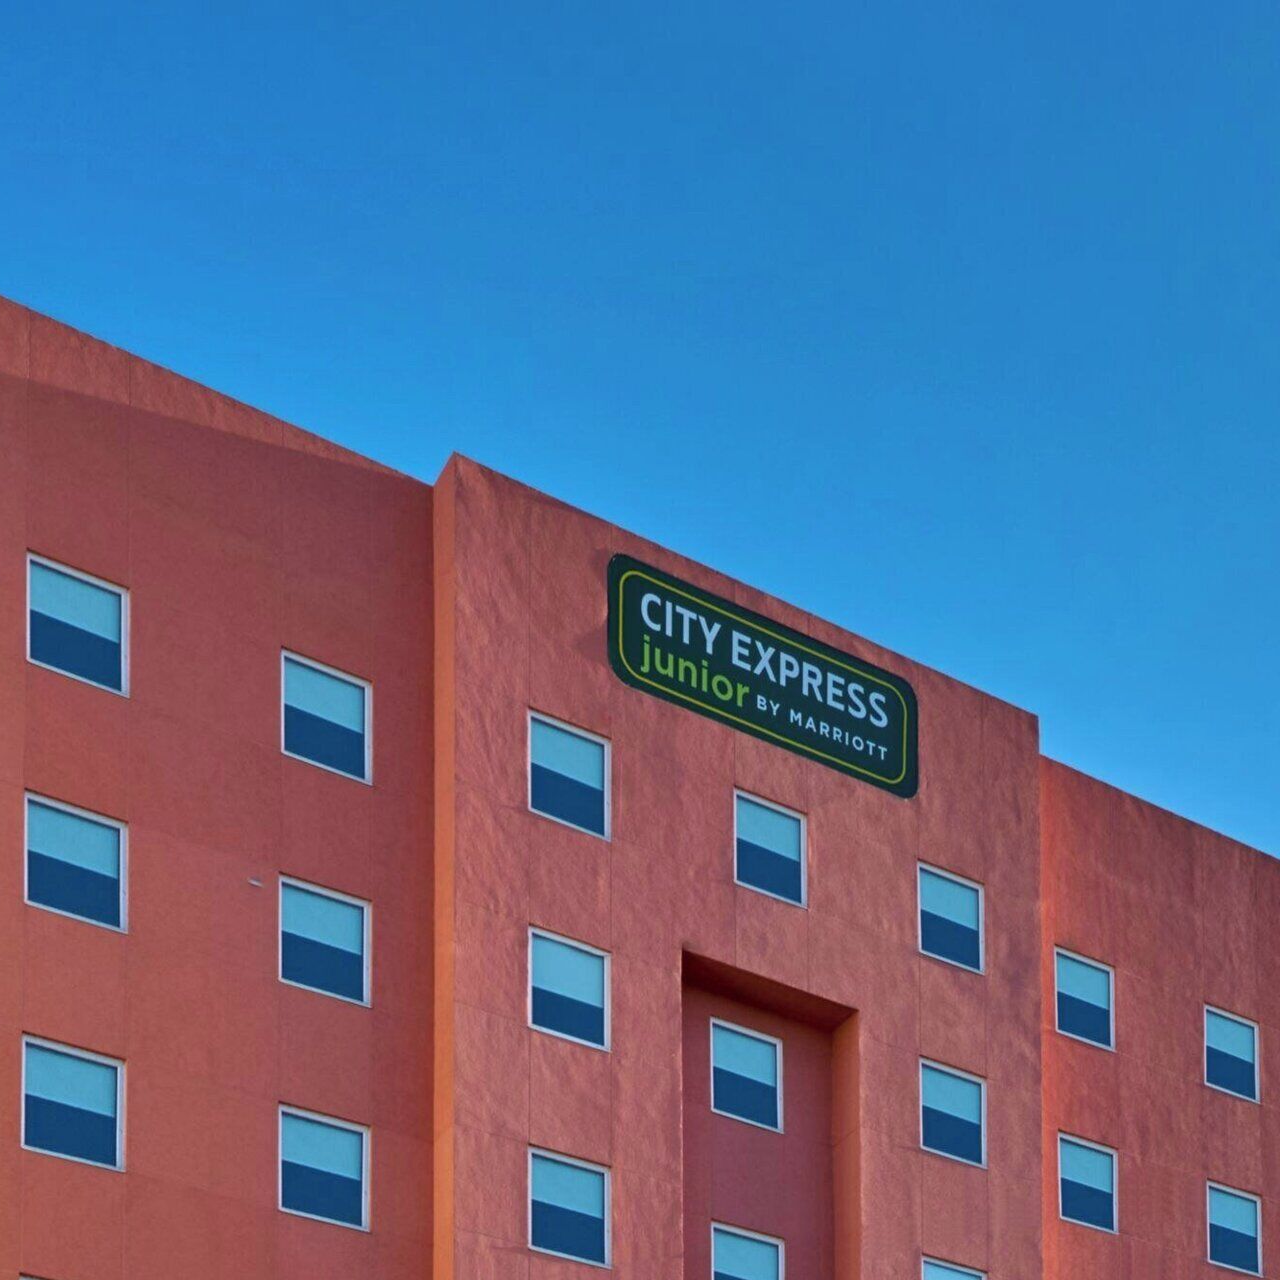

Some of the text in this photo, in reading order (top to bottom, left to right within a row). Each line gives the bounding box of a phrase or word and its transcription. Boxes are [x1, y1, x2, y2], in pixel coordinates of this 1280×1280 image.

[640, 593, 889, 728] CITY EXPRESS
[640, 634, 888, 760] junior BY MARRIOTT
